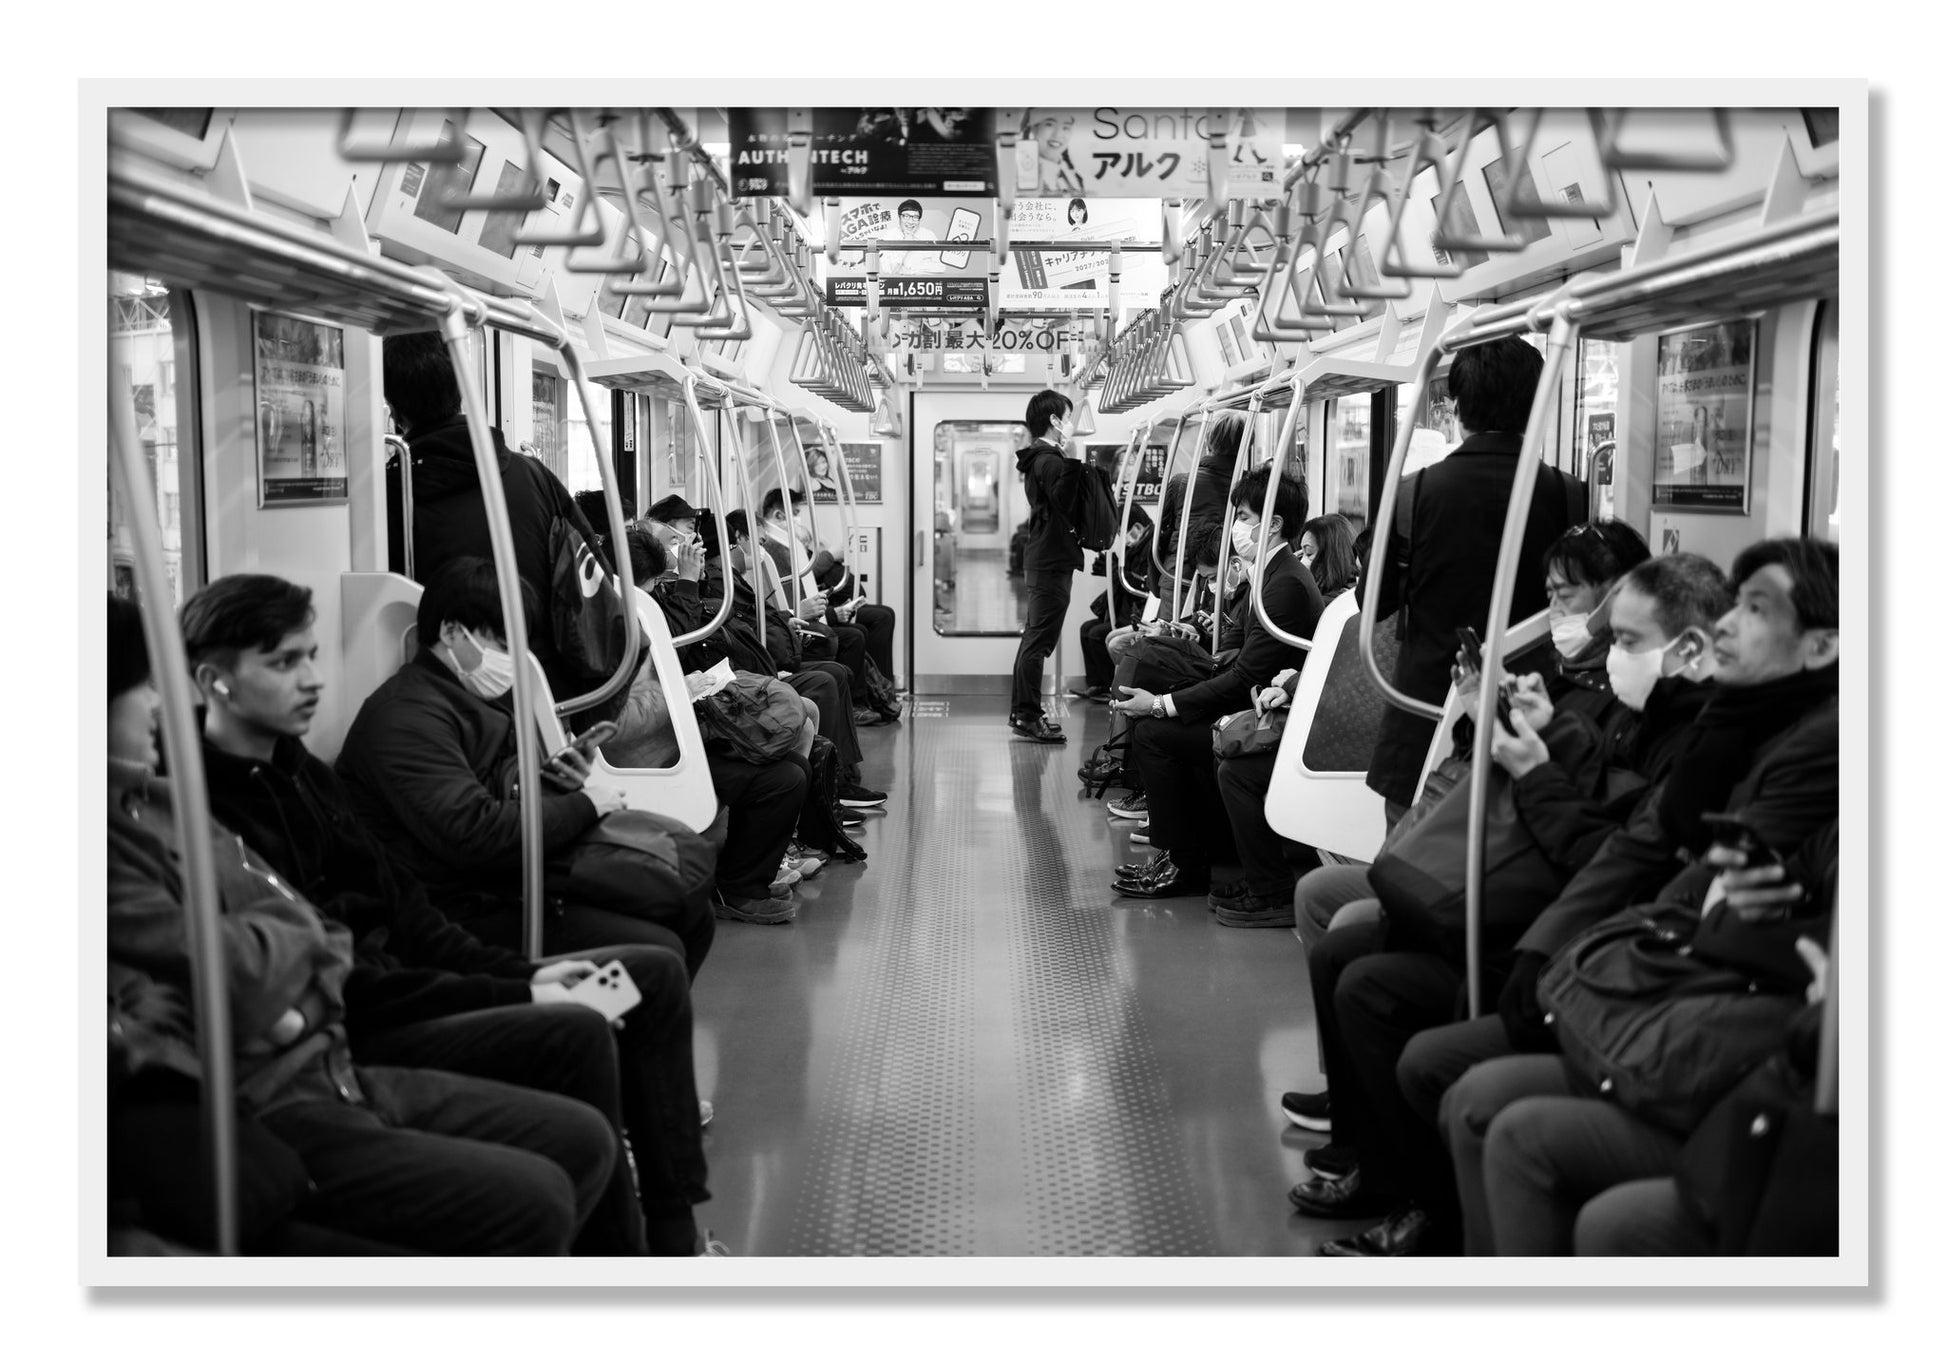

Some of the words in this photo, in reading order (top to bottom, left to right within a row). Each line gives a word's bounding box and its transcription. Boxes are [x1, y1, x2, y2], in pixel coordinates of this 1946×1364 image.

[1092, 152, 1181, 180] アルク
[841, 202, 880, 225] スマホで
[1012, 212, 1057, 221] 会うなら。
[1075, 258, 1109, 272] 2027/202
